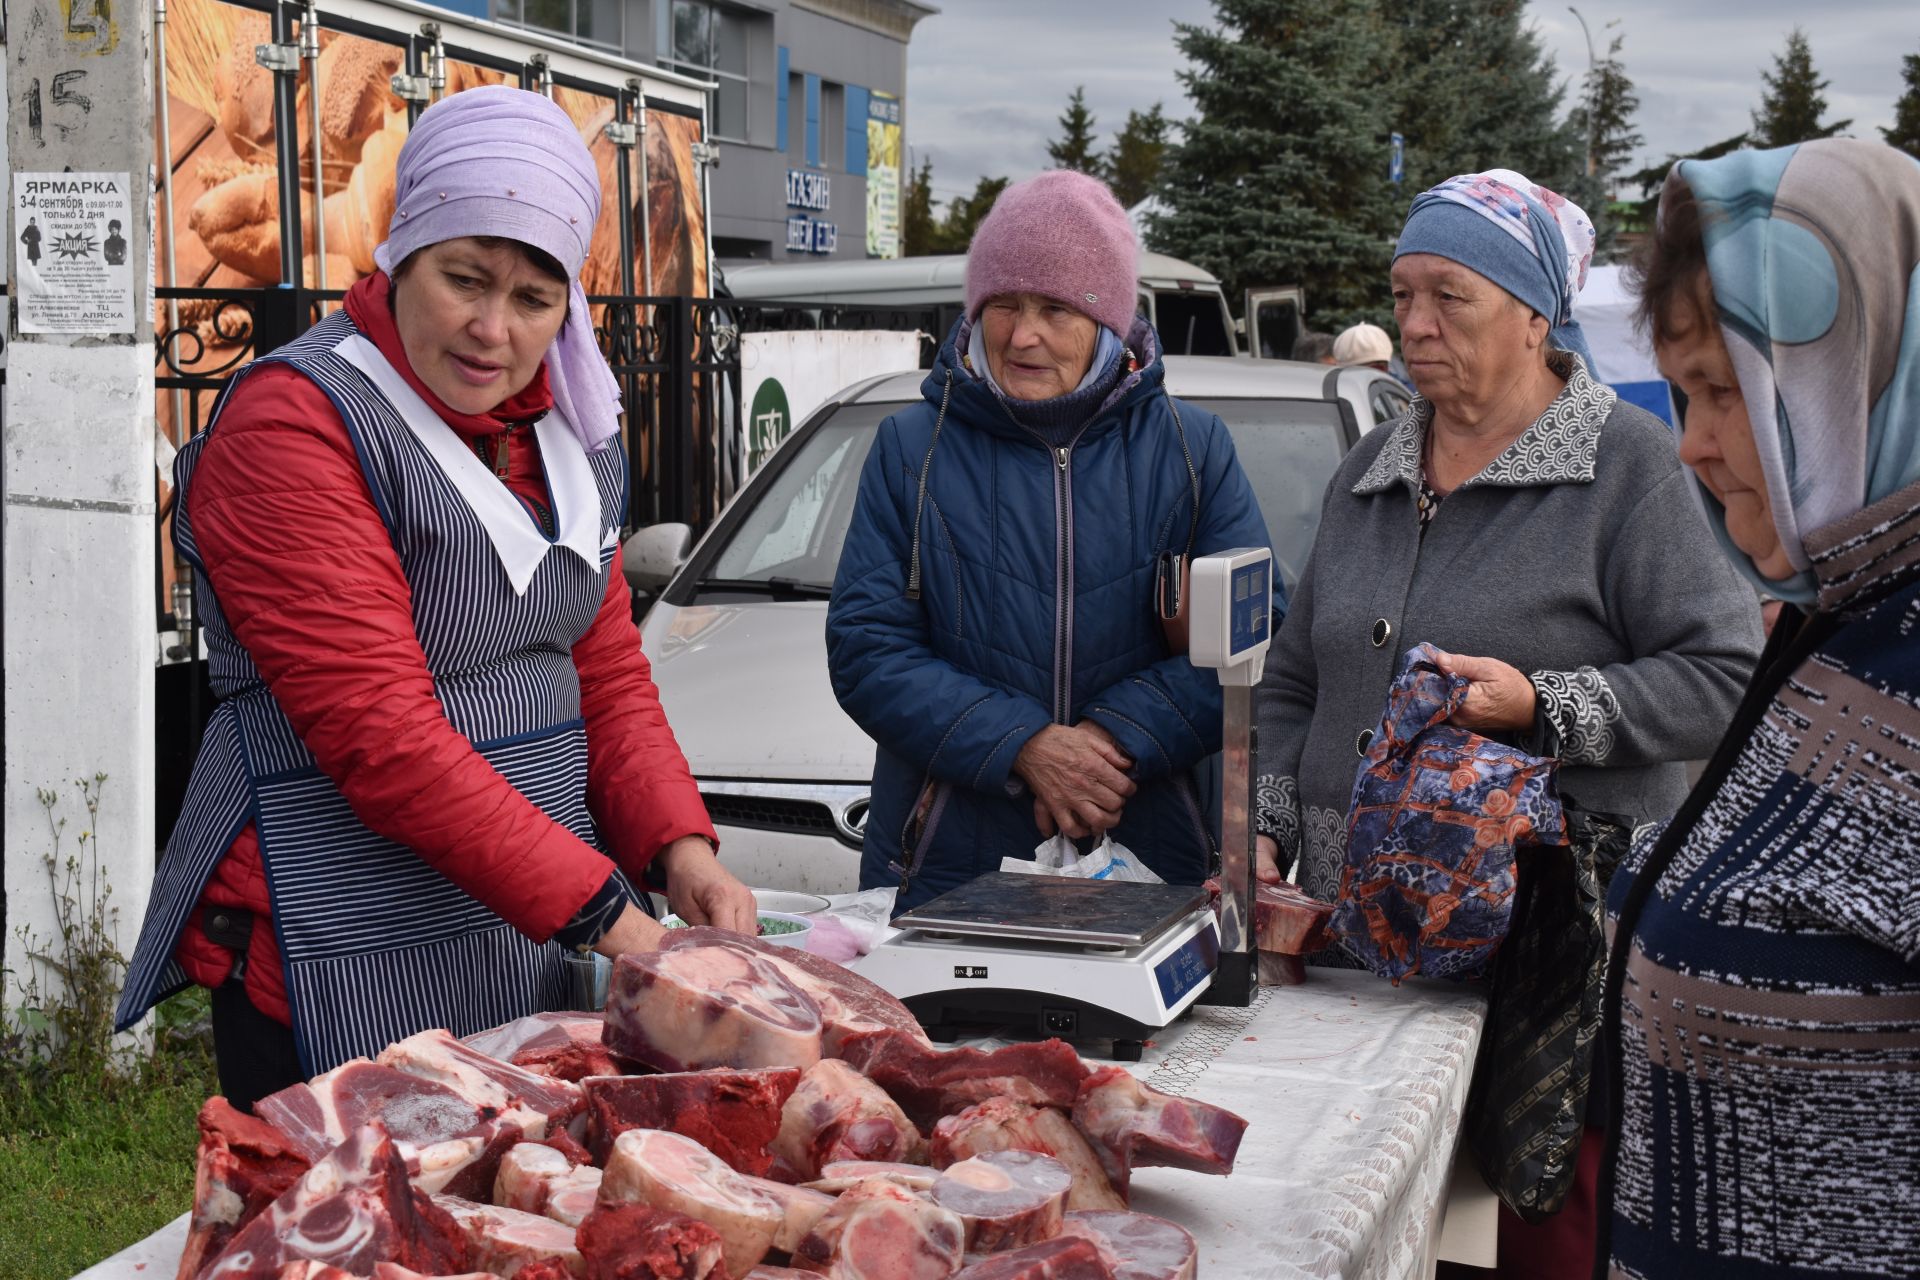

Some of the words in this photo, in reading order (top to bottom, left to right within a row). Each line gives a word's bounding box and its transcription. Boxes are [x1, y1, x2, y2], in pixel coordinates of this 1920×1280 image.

[26, 181, 118, 194] ЯРМАРКА
[20, 195, 36, 208] 3-4
[39, 196, 83, 211] сентября
[43, 211, 76, 219] только
[79, 210, 85, 219] 2
[87, 211, 105, 220] дня
[84, 222, 97, 230] 50%
[60, 239, 88, 252] АКЦИЯ
